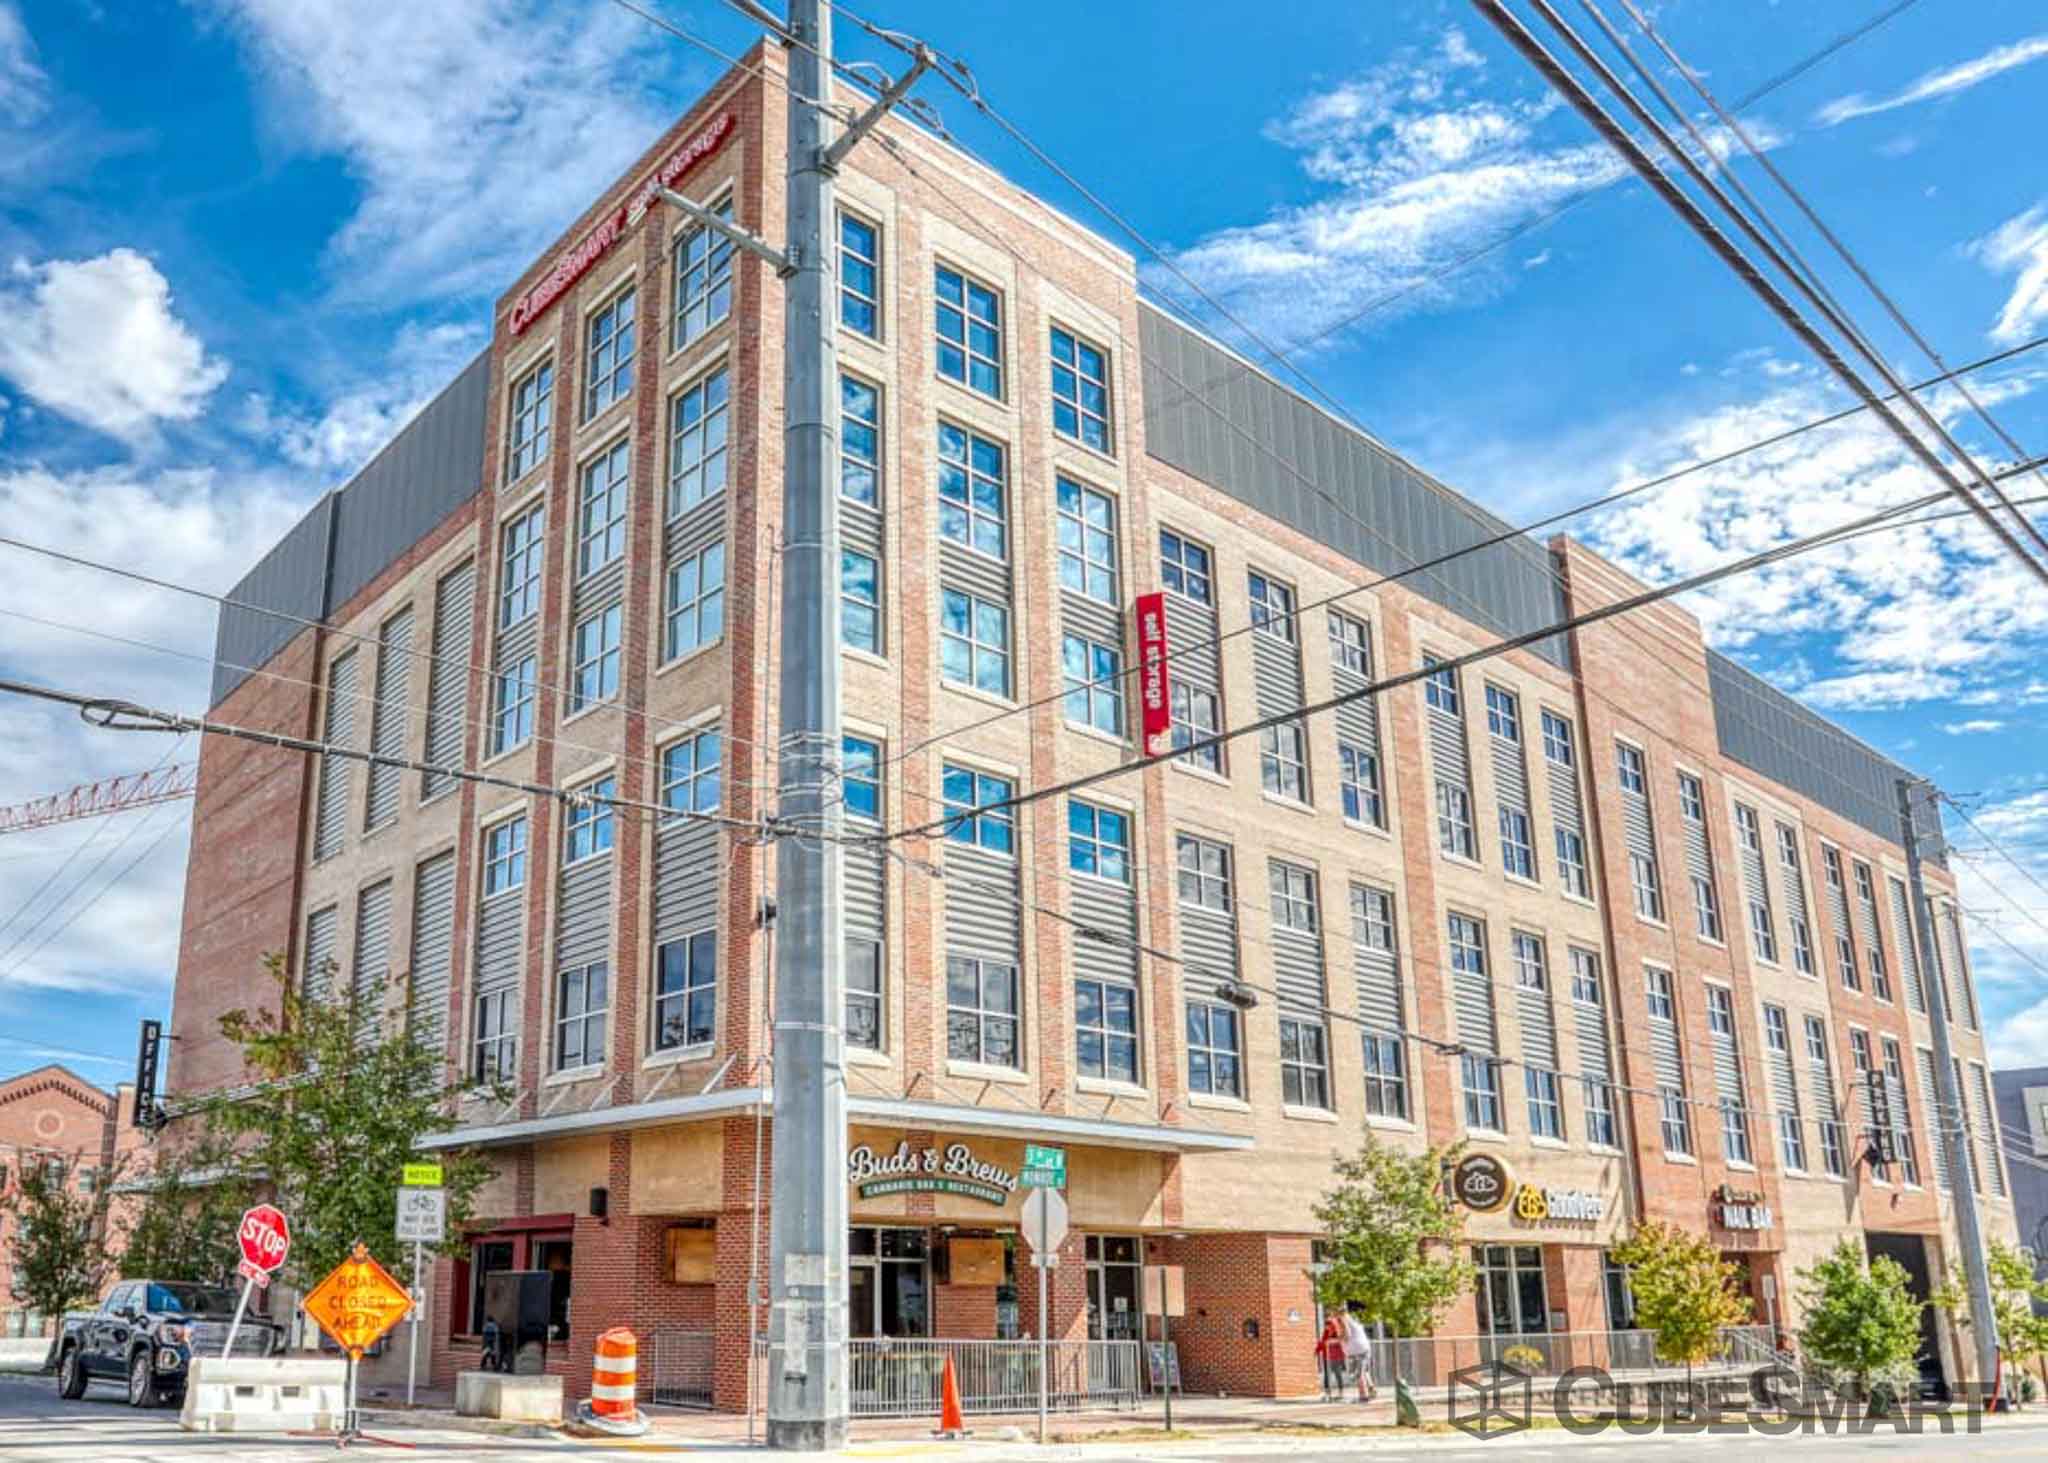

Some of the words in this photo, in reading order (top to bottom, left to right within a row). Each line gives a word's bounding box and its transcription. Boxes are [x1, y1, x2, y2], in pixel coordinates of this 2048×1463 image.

[139, 1024, 158, 1122] OFFICE
[850, 1140, 919, 1182] Buds
[923, 1148, 941, 1173] &
[943, 1143, 1020, 1192] Brews
[243, 1218, 286, 1257] STOP
[337, 1275, 379, 1289] ROAD
[328, 1295, 387, 1310] CLOSED
[332, 1312, 381, 1330] AHEAD
